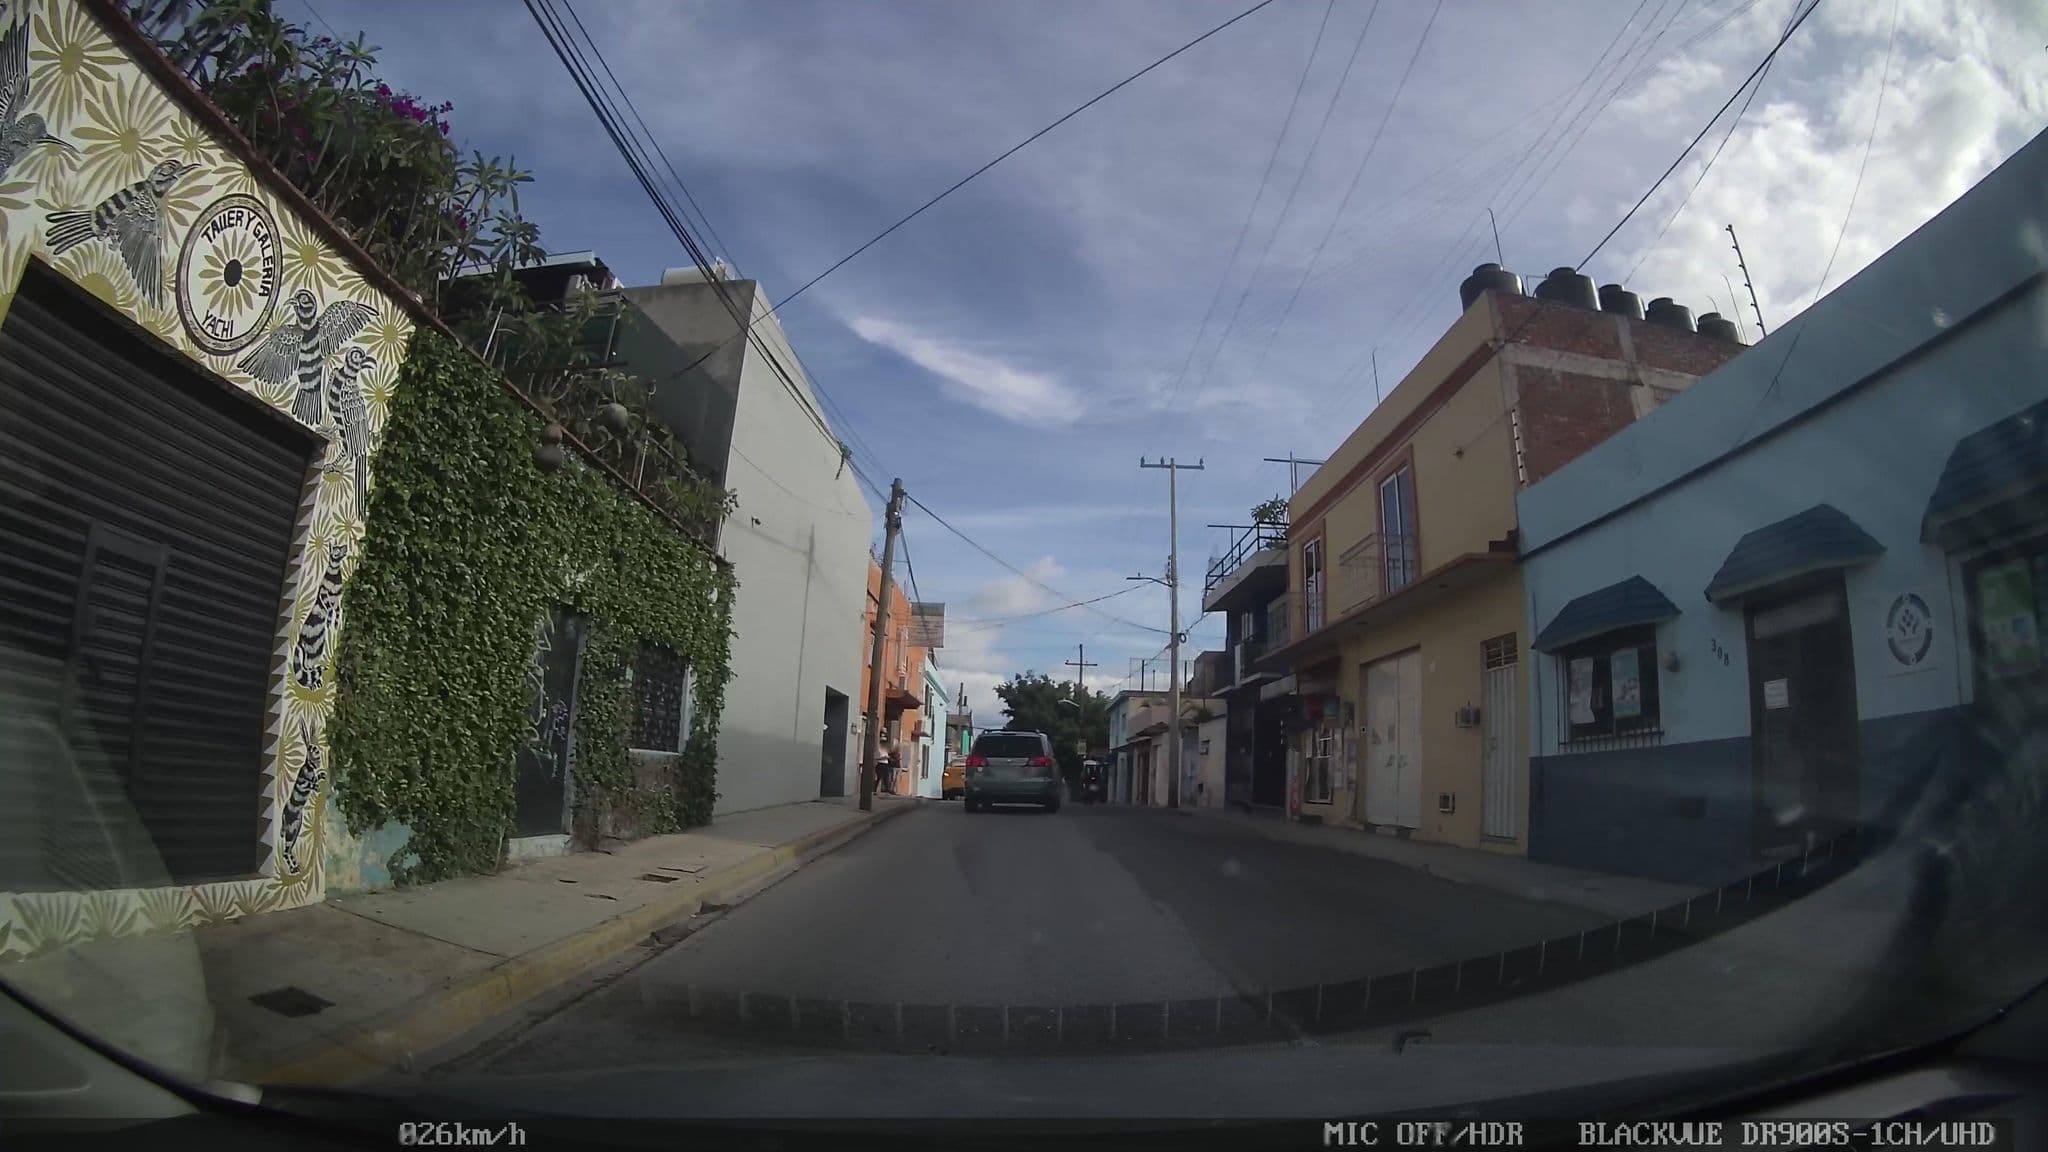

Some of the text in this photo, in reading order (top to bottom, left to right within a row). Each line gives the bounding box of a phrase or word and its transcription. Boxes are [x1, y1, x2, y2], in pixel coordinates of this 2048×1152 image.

[245, 211, 257, 231] Y
[252, 221, 274, 297] GALERIA
[201, 309, 234, 338] YACHI
[1711, 638, 1729, 667] 308
